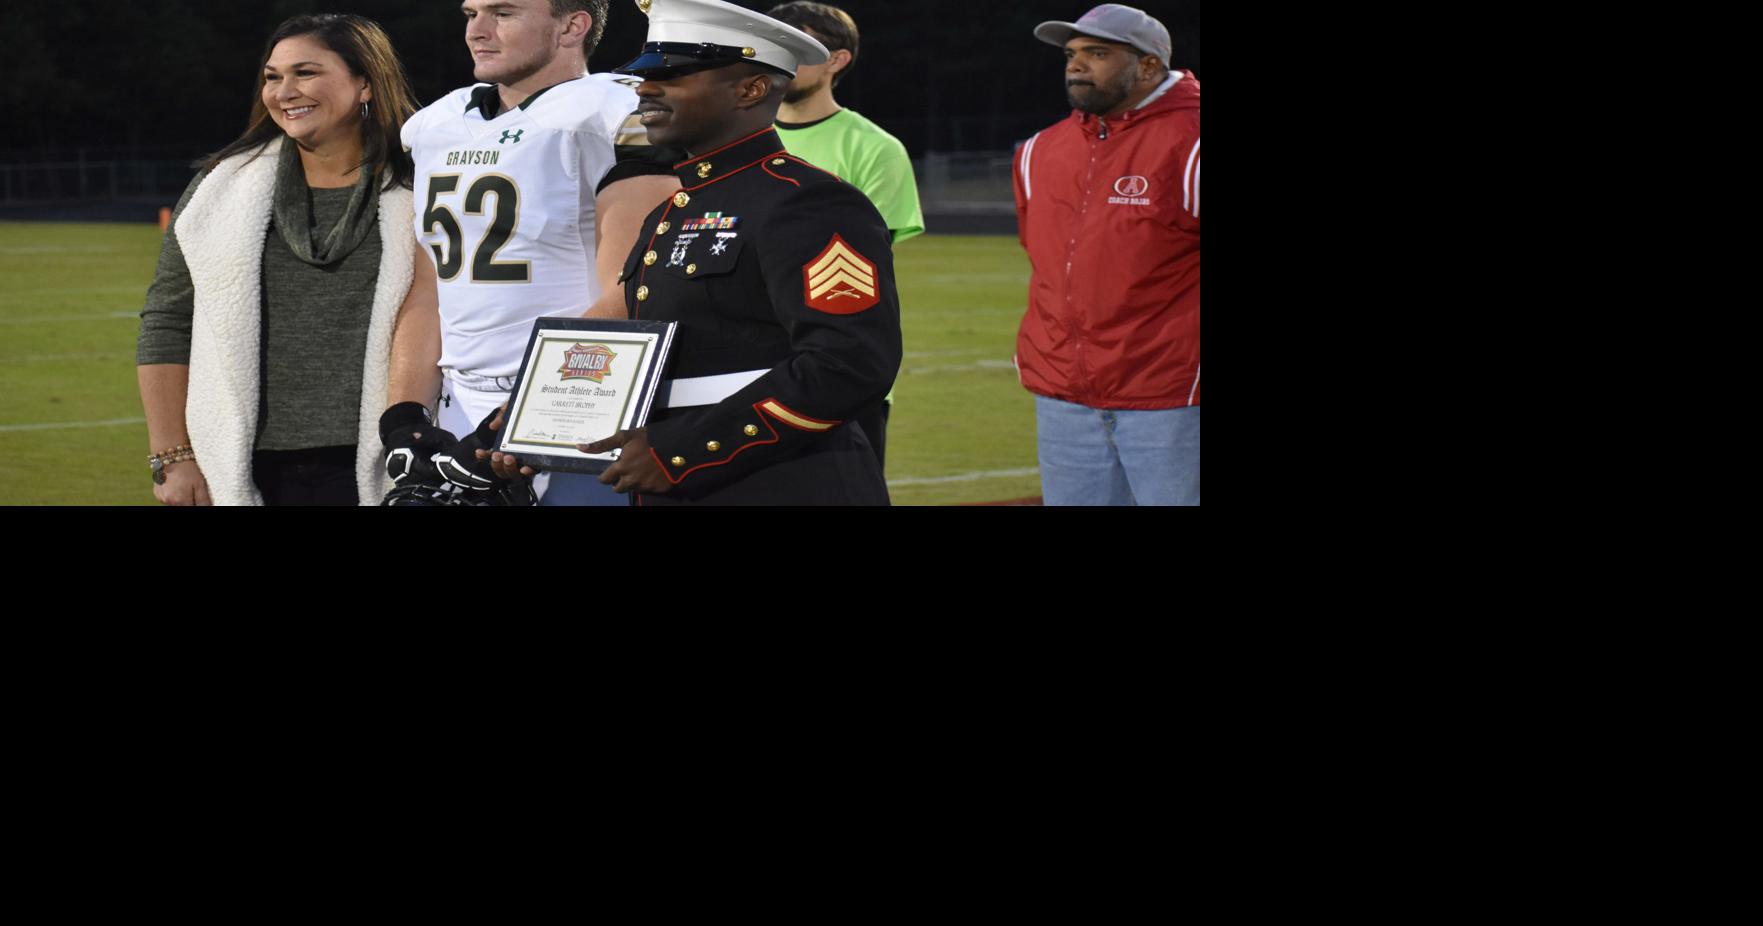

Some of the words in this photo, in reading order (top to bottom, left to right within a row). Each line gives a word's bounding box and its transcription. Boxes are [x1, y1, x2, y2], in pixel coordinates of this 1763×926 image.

[446, 150, 500, 166] GRAYSON
[423, 172, 532, 283] 52
[568, 353, 607, 370] RIVALRY
[541, 384, 568, 395] Student
[569, 386, 593, 397] Athlete
[593, 387, 616, 398] Award
